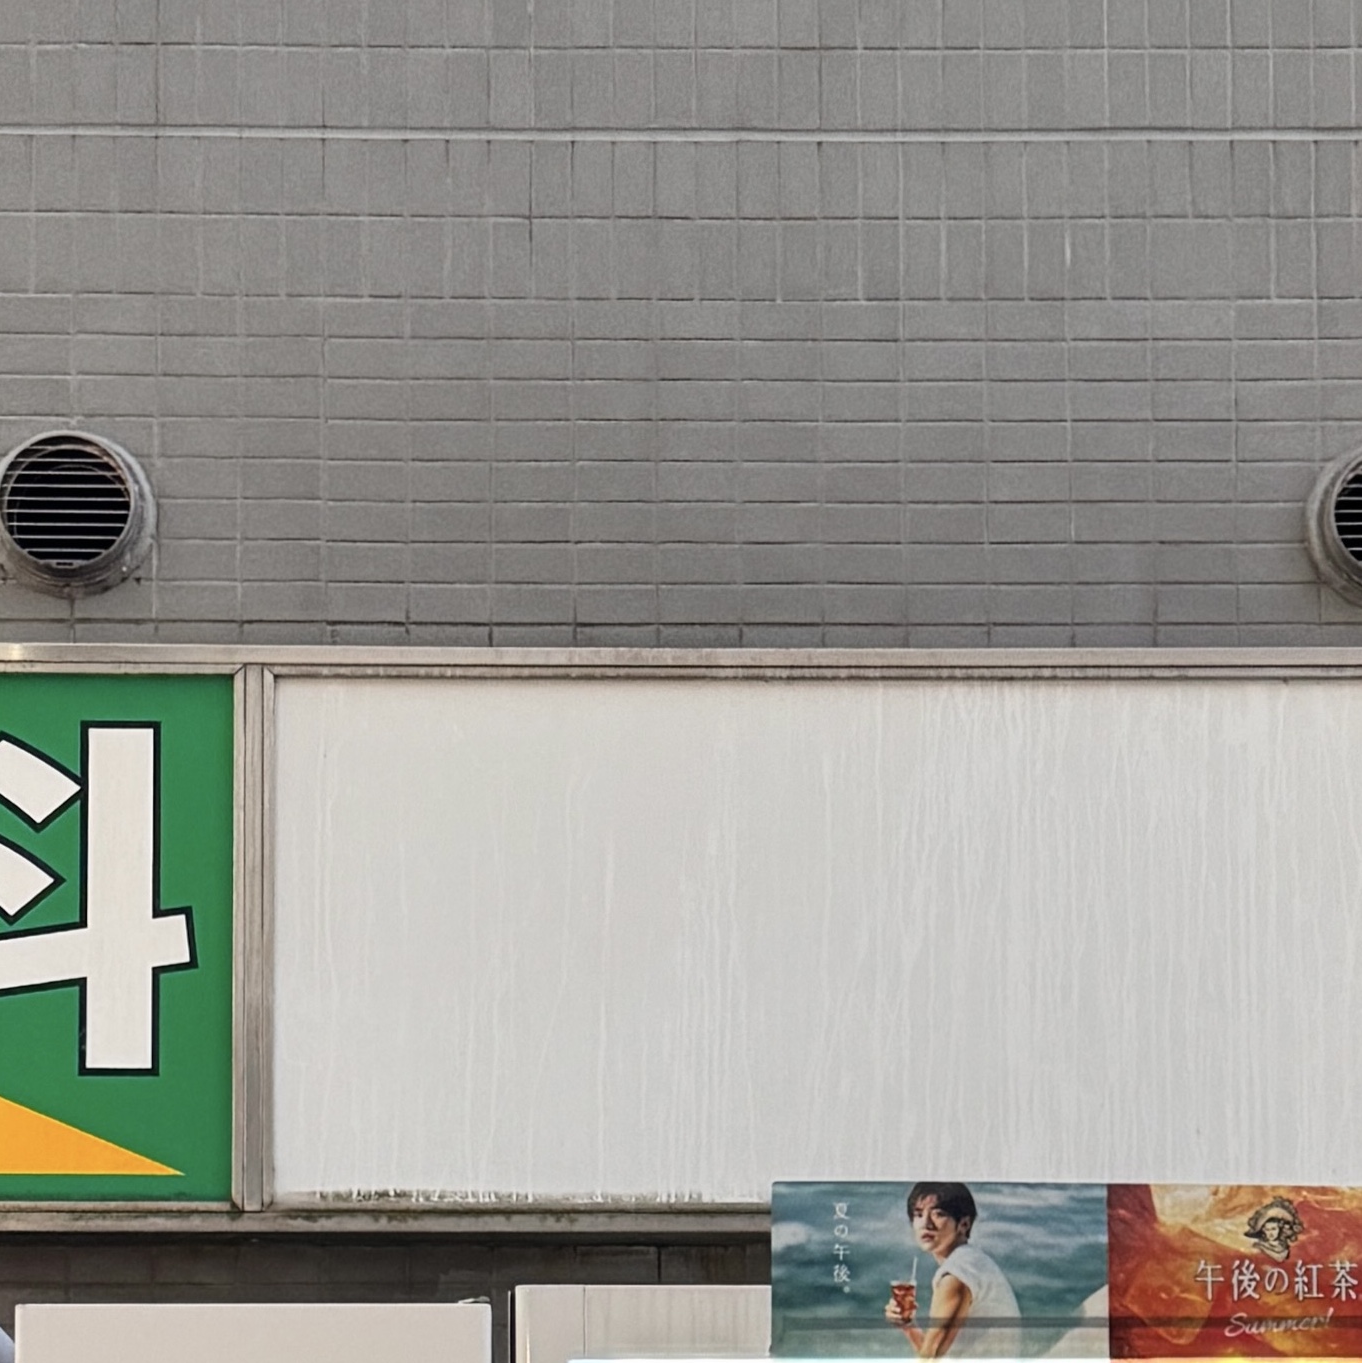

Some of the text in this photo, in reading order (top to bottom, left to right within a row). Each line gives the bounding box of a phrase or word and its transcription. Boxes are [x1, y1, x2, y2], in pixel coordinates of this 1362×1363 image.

[1195, 1258, 1359, 1303] 午後の紅茶
